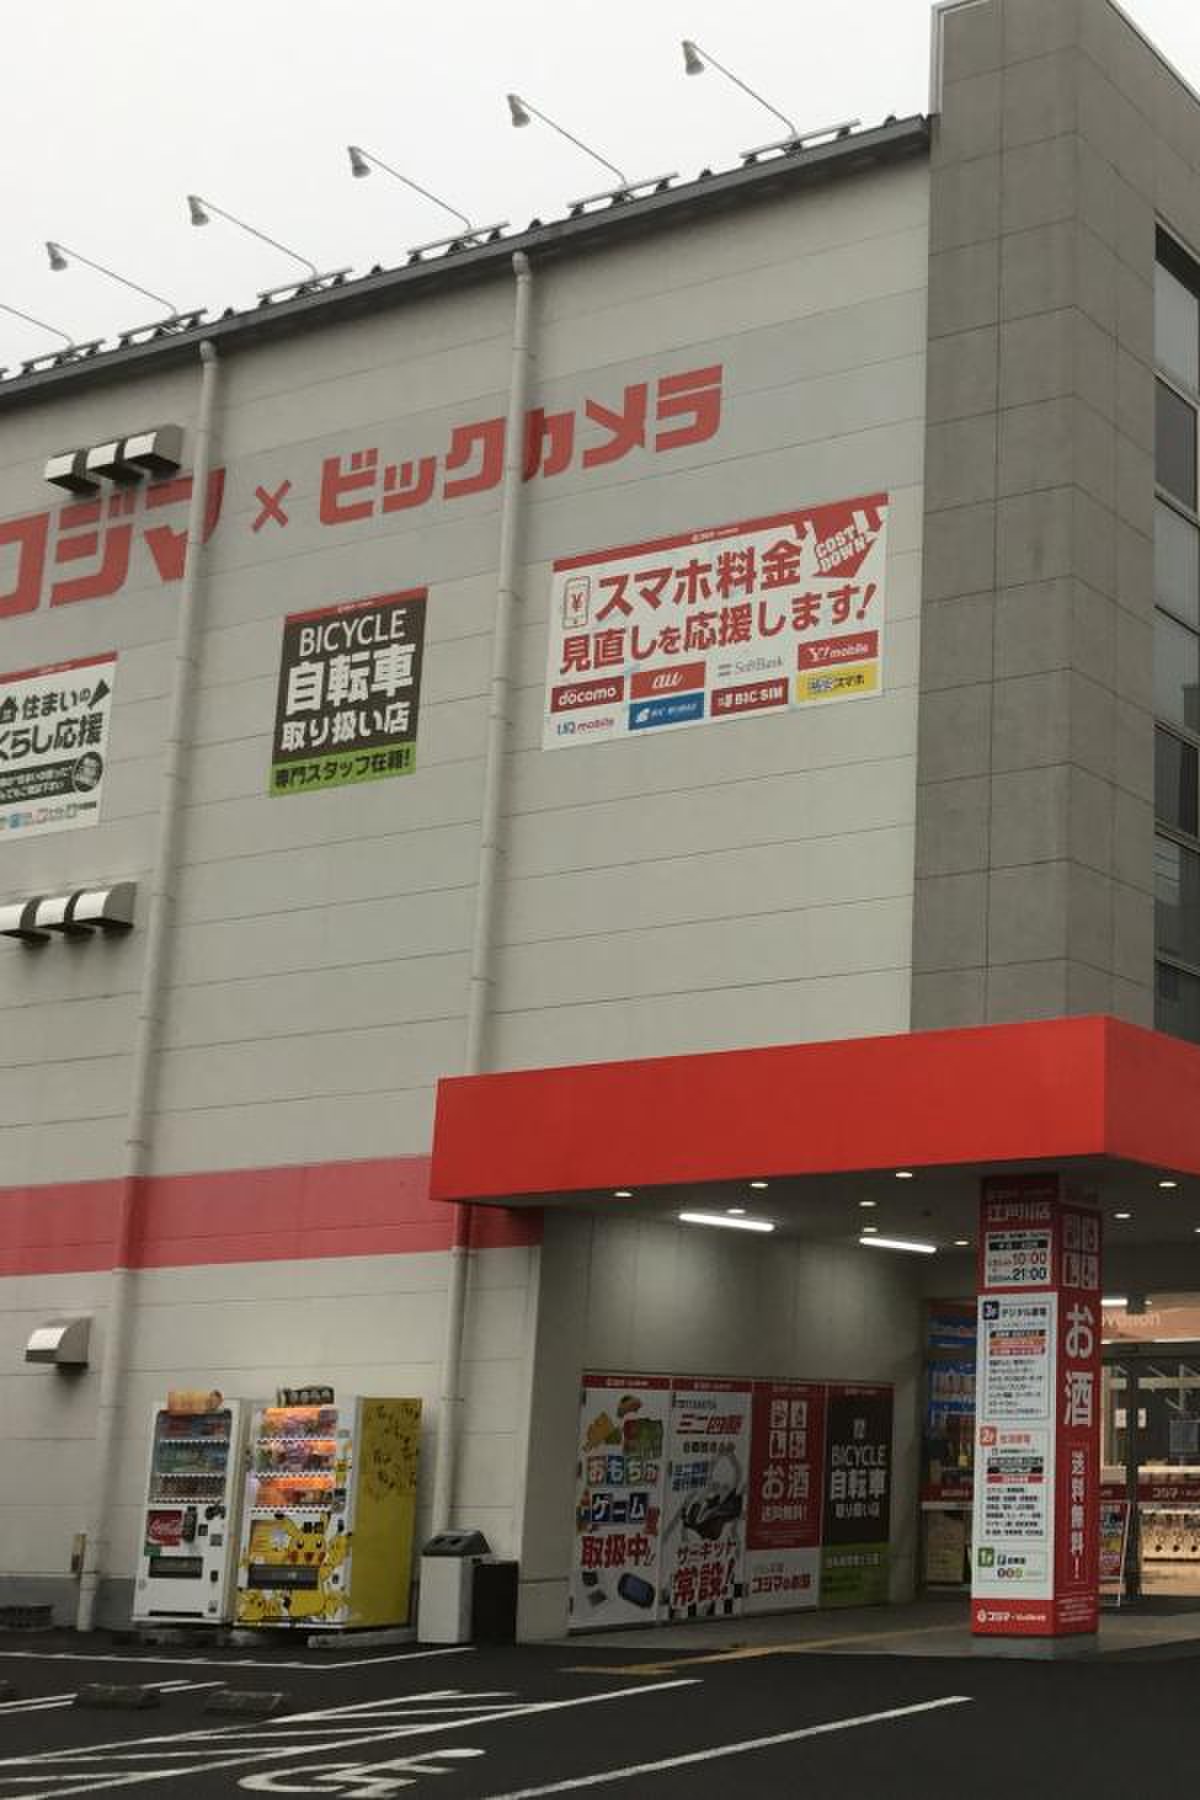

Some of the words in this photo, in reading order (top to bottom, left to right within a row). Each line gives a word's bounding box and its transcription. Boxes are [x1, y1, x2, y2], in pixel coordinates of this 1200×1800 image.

[319, 364, 723, 526] ビックカメラ
[595, 538, 802, 622] スマホ料金
[300, 609, 406, 656] BICYCLE
[286, 643, 416, 716] 自転車
[651, 671, 683, 690] au
[735, 656, 783, 675] SoftBank
[559, 687, 617, 707] docomo
[281, 701, 411, 752] 取り扱い店
[1012, 1267, 1047, 1281] 21:00
[1064, 1303, 1095, 1427] お酒
[587, 1456, 660, 1486] おもちゃ
[832, 1444, 887, 1467] BICYCLE
[761, 1463, 811, 1499] お酒
[831, 1469, 886, 1500] 自転車
[592, 1495, 647, 1521] ゲーム
